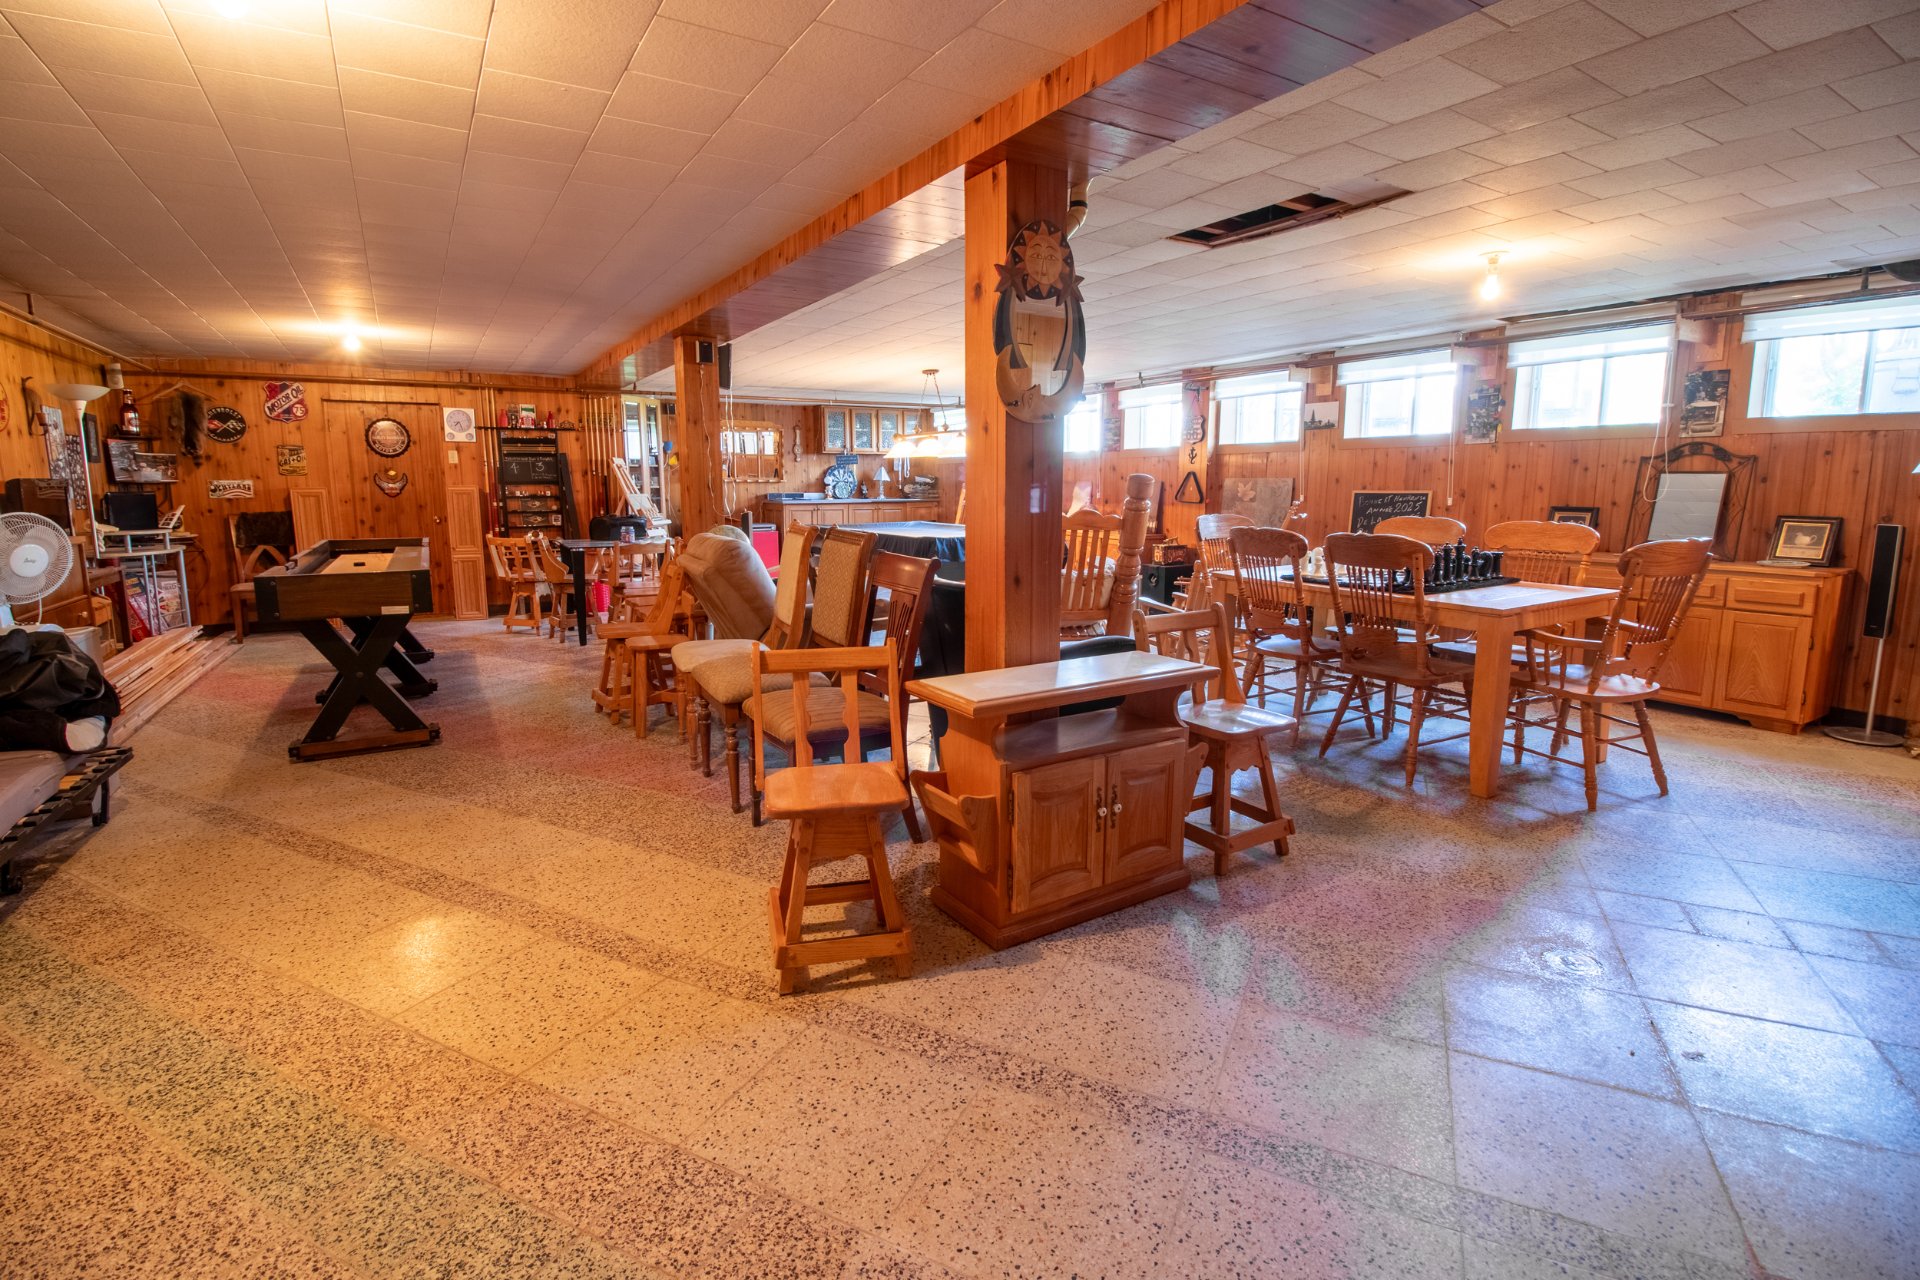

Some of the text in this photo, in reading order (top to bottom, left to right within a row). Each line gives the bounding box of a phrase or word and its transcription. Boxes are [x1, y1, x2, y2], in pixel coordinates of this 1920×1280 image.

[267, 385, 304, 415] MOTOR OIL
[295, 406, 304, 415] 75
[535, 461, 545, 471] 3
[1394, 501, 1424, 513] 2025
